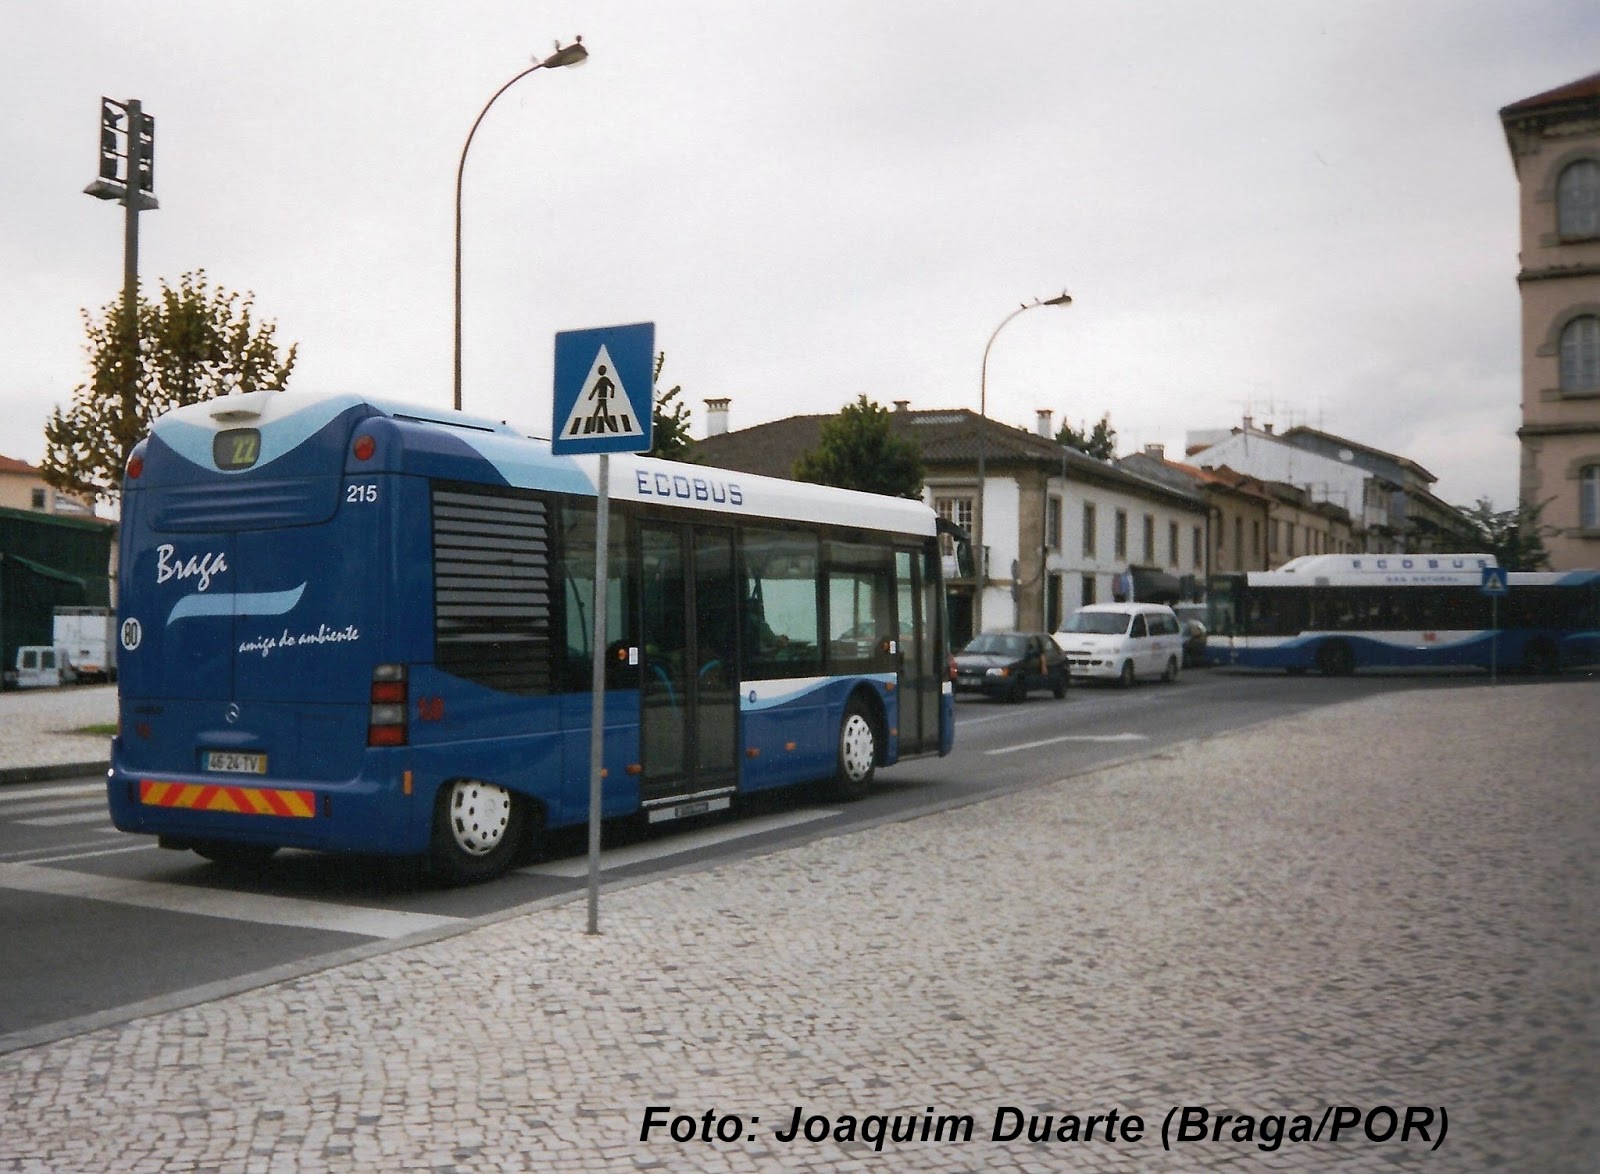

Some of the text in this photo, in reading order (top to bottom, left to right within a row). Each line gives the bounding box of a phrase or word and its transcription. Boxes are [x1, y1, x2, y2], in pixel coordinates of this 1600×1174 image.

[347, 485, 378, 503] 215
[636, 470, 743, 506] ECOBUS
[156, 544, 228, 591] Braga
[1353, 559, 1487, 569] ECOBUS
[124, 622, 138, 646] 80
[279, 628, 296, 647] do
[298, 623, 360, 645] ambiente
